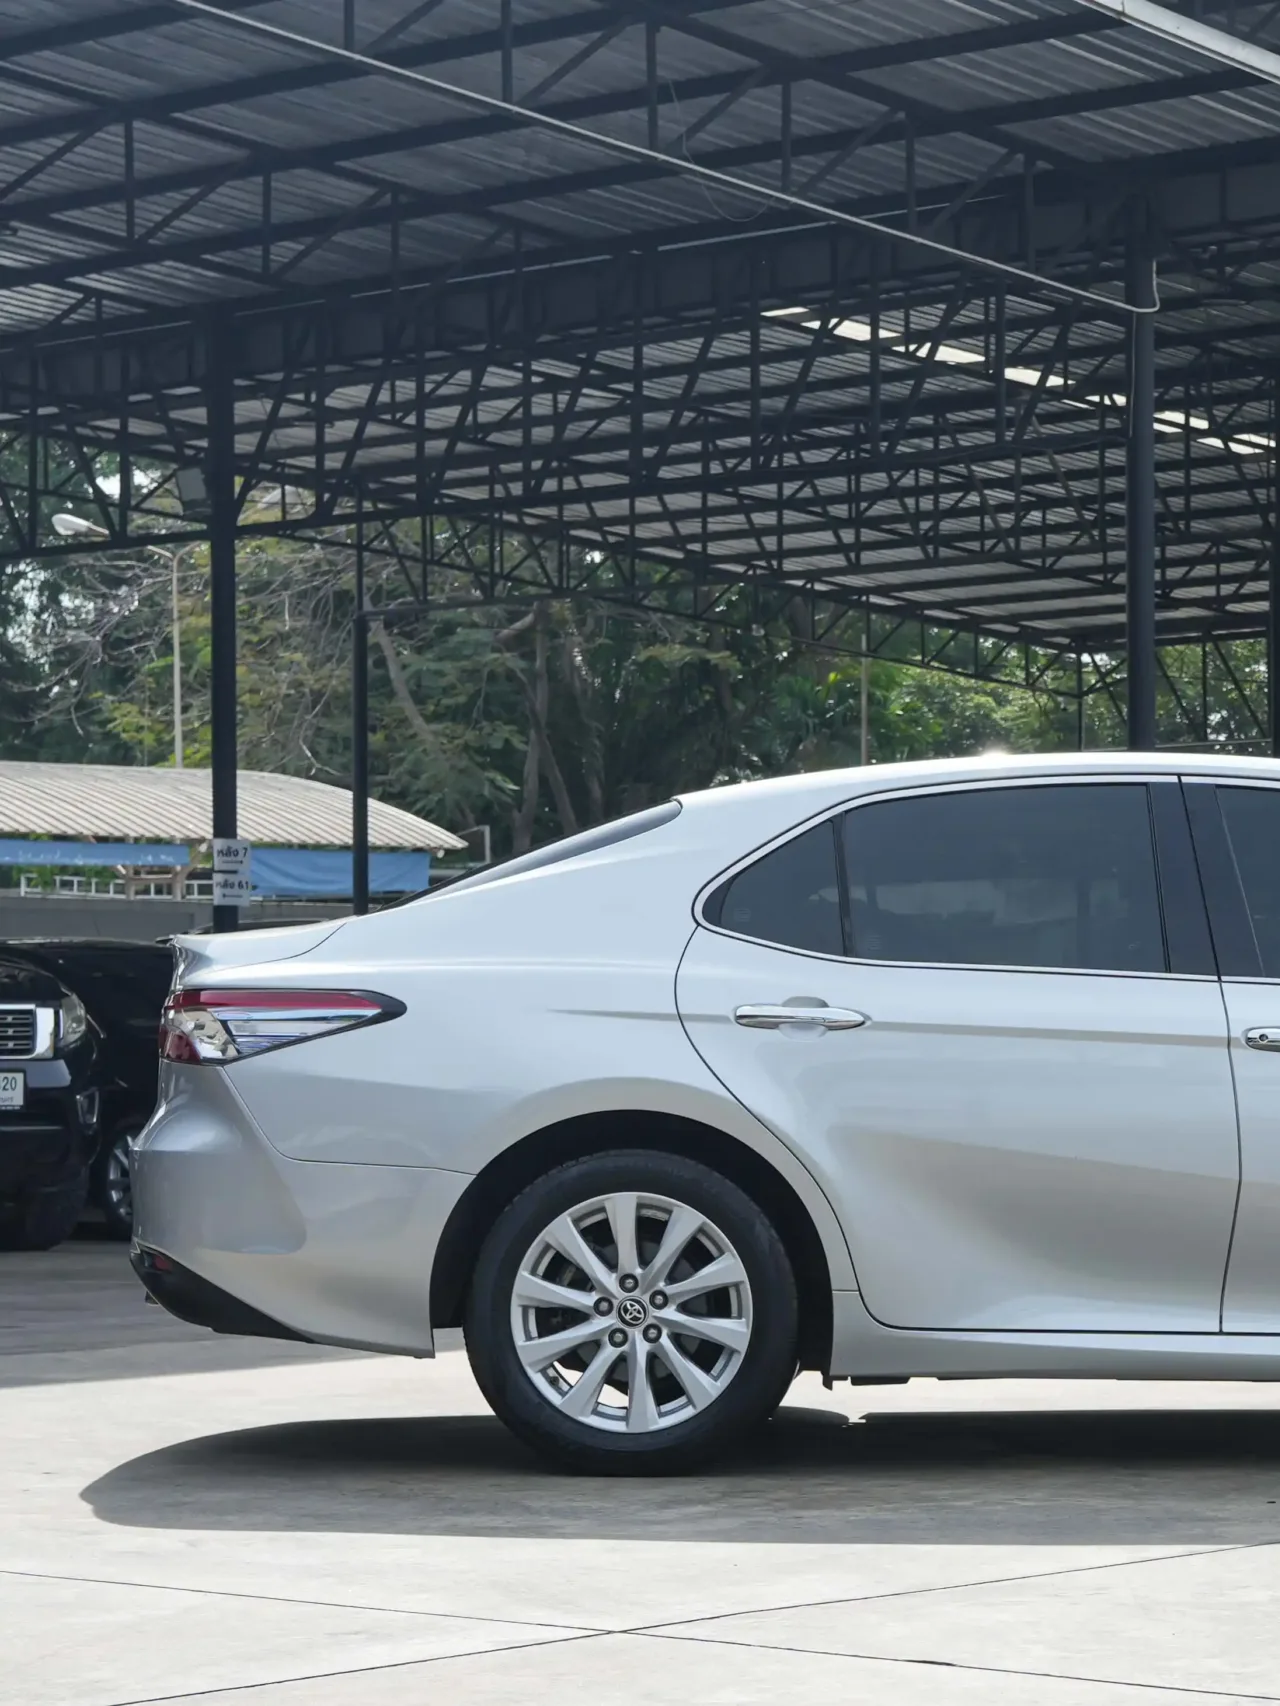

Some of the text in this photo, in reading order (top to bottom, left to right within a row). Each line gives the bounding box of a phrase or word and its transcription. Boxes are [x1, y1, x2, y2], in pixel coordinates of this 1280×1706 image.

[216, 845, 248, 858] หลัง 7
[0, 1076, 18, 1092] 20
